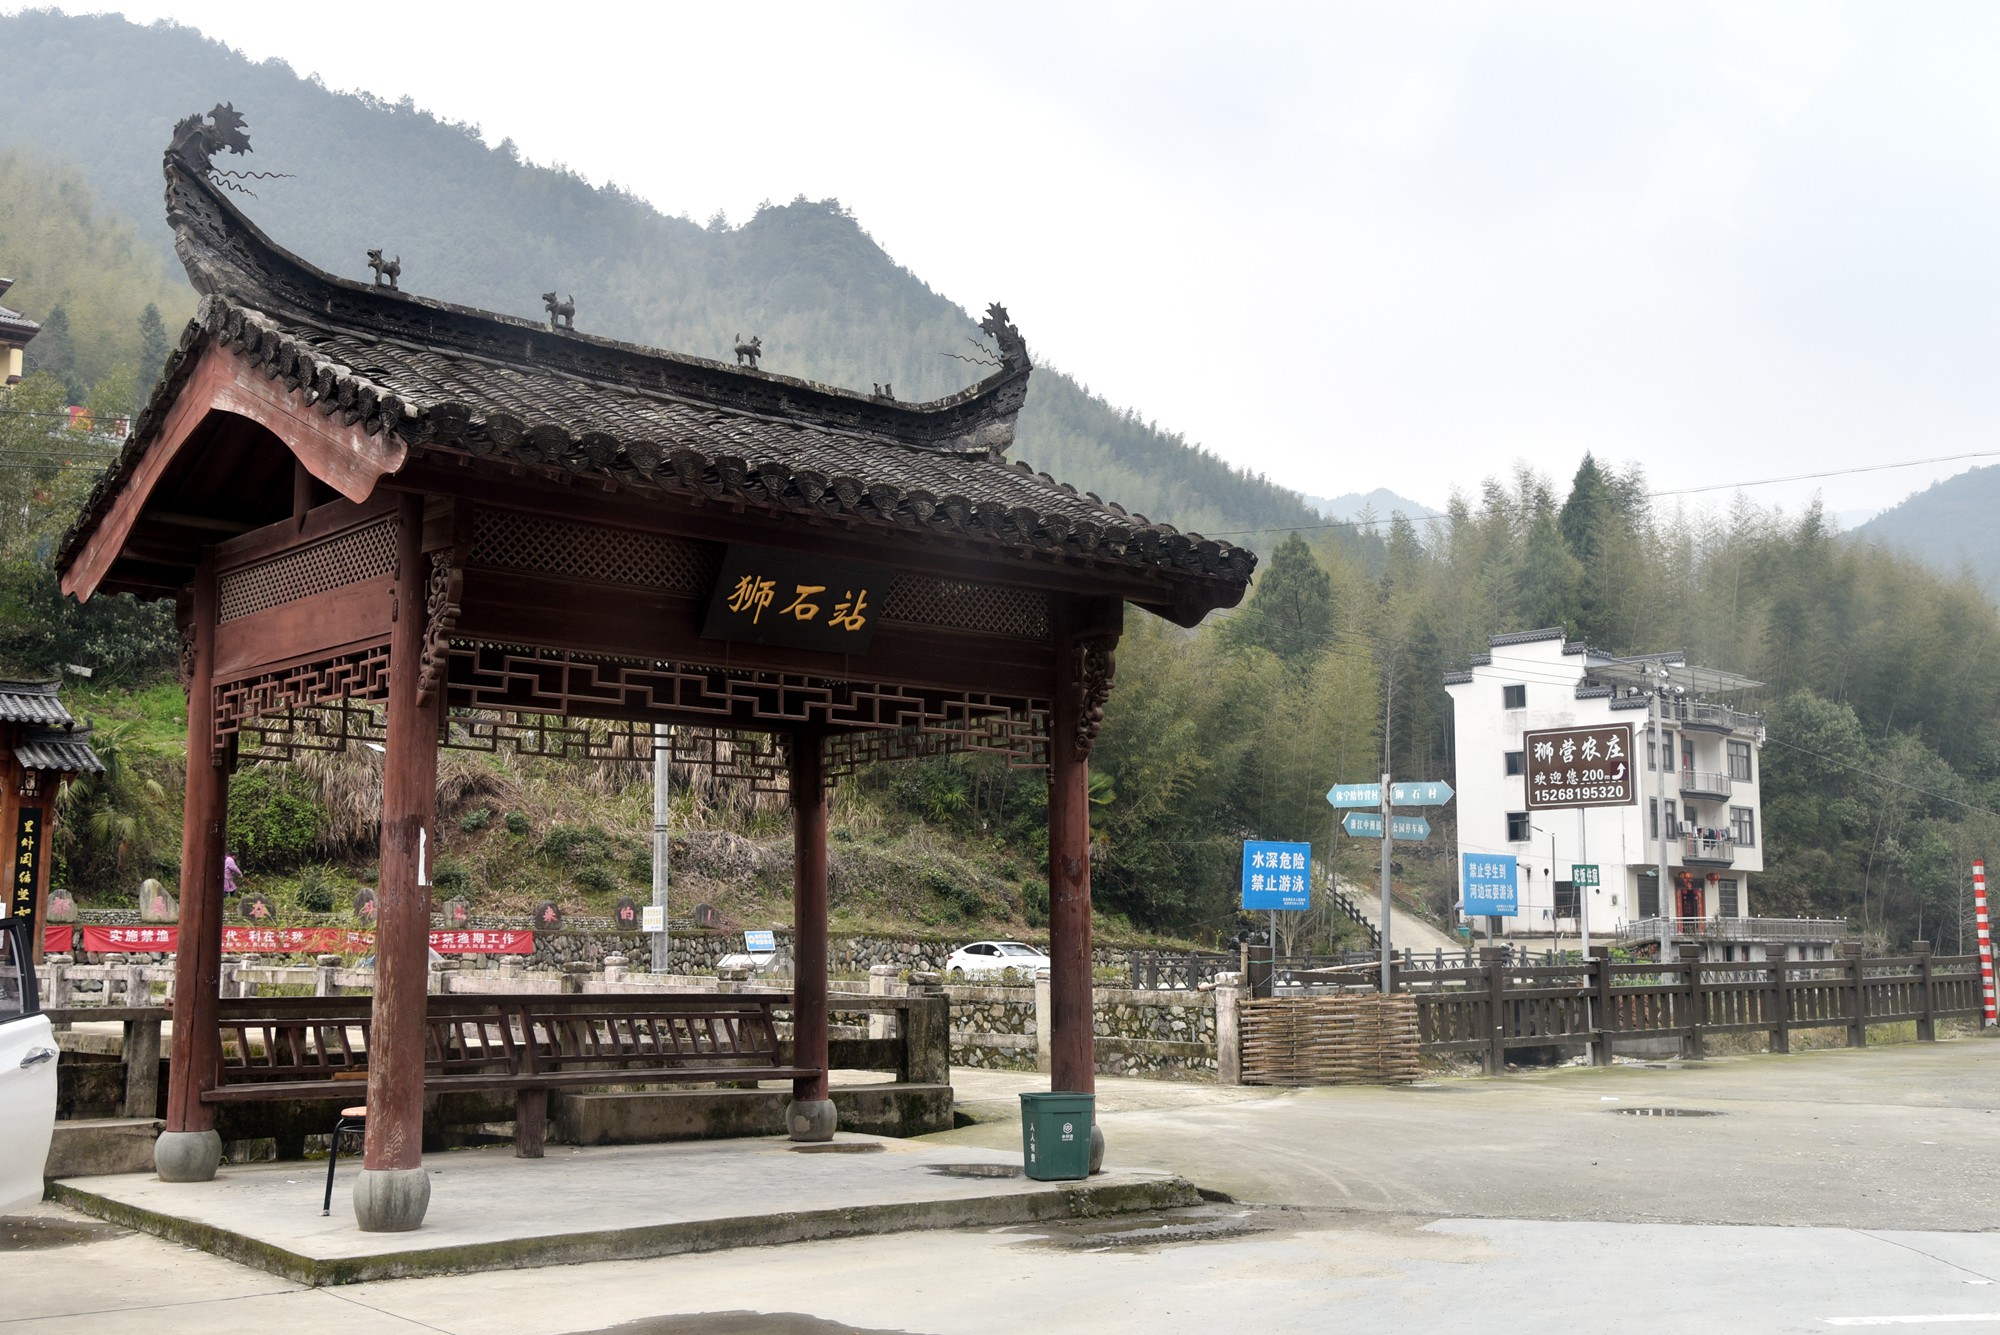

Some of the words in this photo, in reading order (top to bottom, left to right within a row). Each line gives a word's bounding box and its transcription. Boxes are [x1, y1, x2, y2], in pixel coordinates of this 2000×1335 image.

[727, 575, 867, 631] 狮石站
[1533, 734, 1624, 765] 狮营农庄
[1534, 768, 1579, 786] 欢迎您
[1534, 785, 1624, 801] 15268195320
[1252, 850, 1305, 869] 水深危险
[1469, 862, 1506, 880] 禁止学生到
[1251, 874, 1305, 893] 禁止游泳
[620, 906, 634, 921] 的
[109, 929, 170, 942] 实施禁渔
